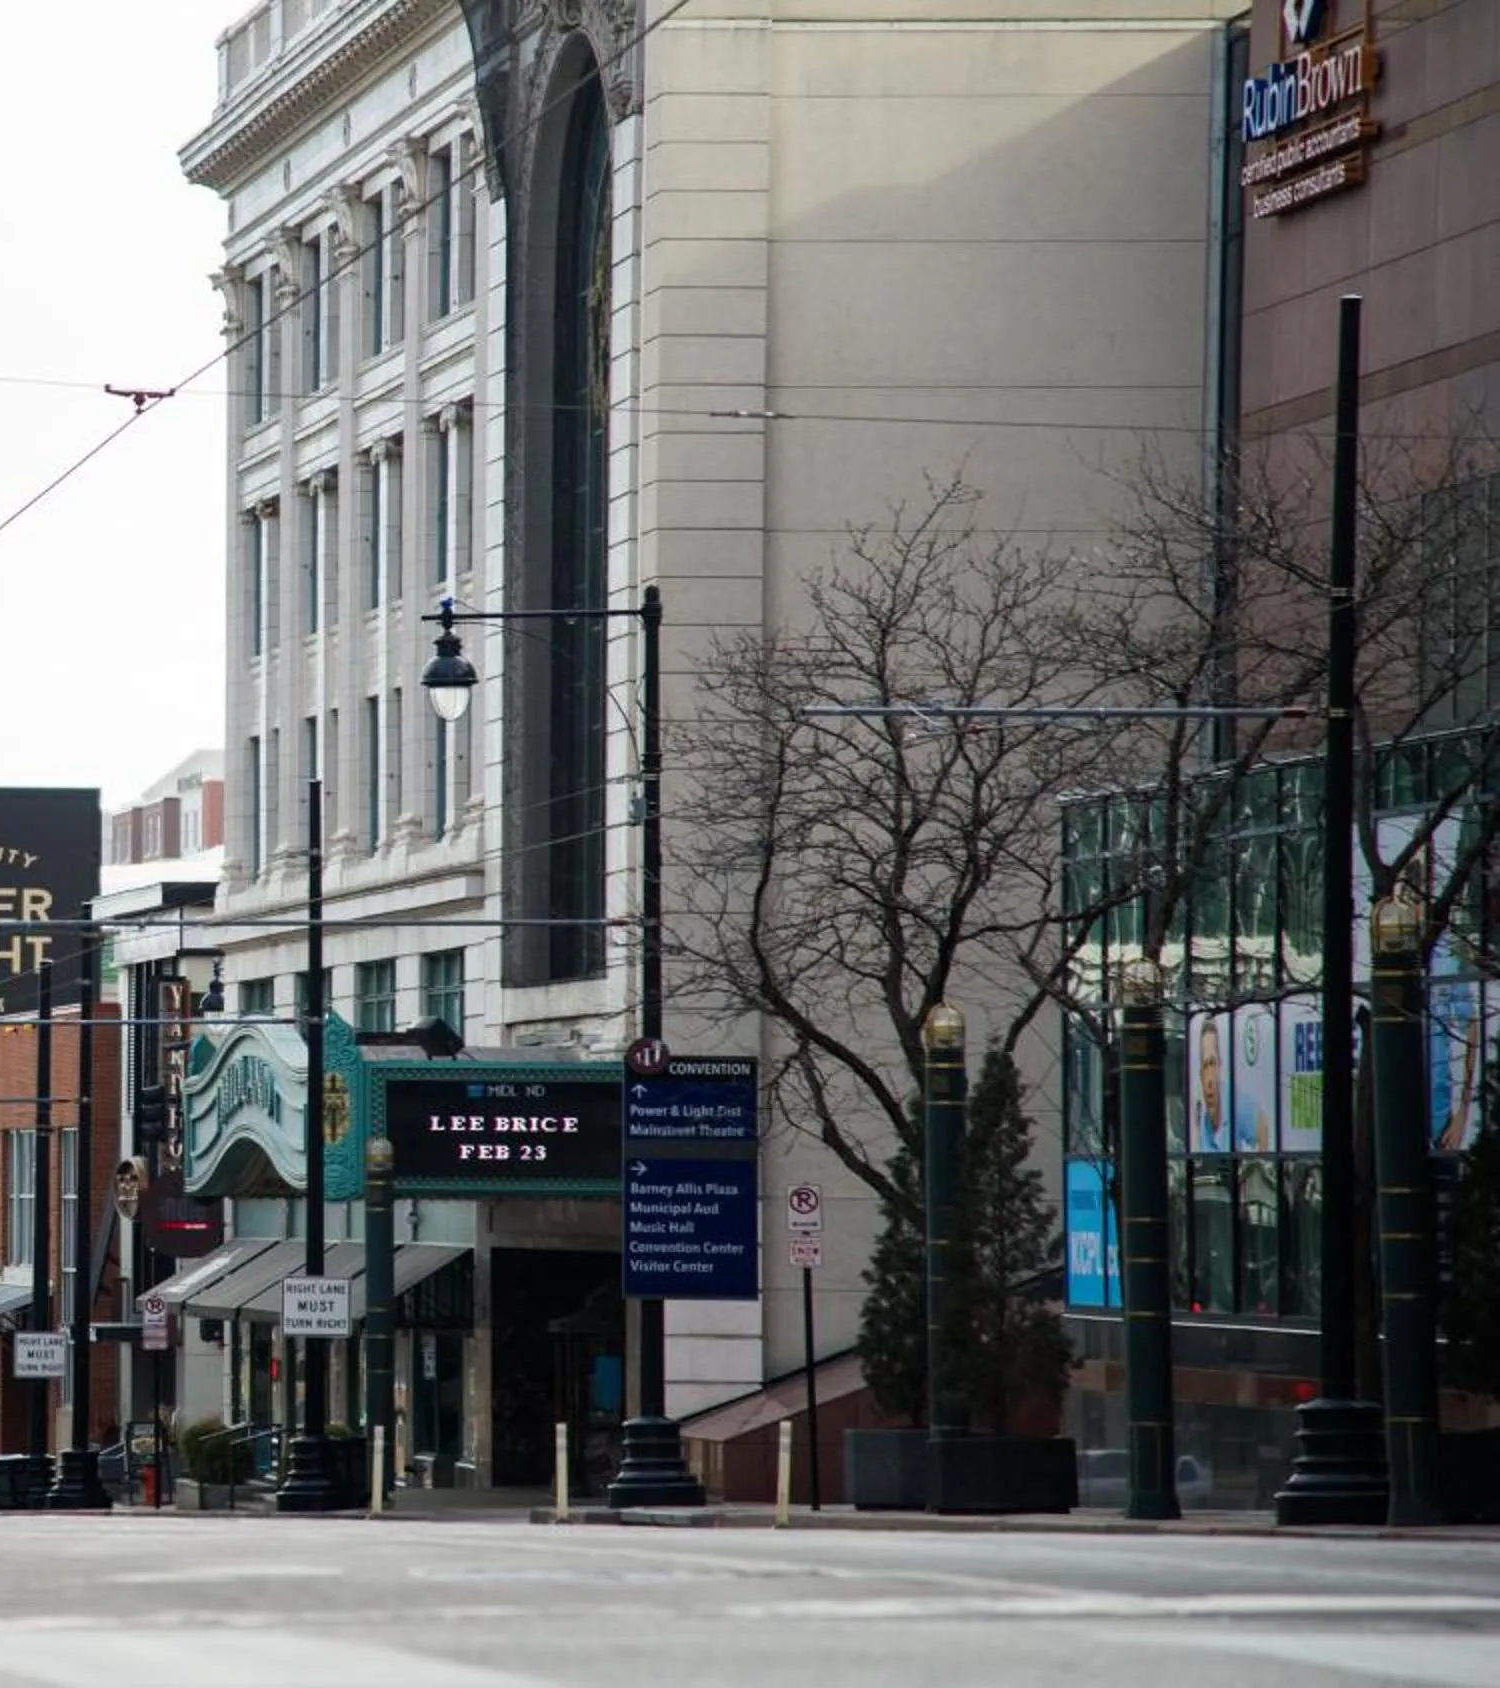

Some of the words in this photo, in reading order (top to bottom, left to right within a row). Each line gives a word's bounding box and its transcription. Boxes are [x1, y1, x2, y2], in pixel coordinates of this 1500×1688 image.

[1241, 46, 1363, 143] RubinBrown
[668, 1062, 751, 1075] CONVENTION
[629, 1104, 668, 1117] Power
[670, 1104, 681, 1117] &
[683, 1104, 715, 1119] Light
[430, 1116, 485, 1131] LEE
[495, 1117, 579, 1133] BRICE
[460, 1145, 510, 1160] FEB
[520, 1145, 547, 1161] 23
[630, 1182, 673, 1198] Barney
[675, 1183, 703, 1195] Allis
[705, 1183, 739, 1195] Plaza
[629, 1202, 692, 1216] Municipal
[694, 1202, 720, 1215] Aud
[629, 1221, 667, 1233] Music
[668, 1221, 695, 1233] Hall
[629, 1241, 701, 1253] Convention
[703, 1241, 744, 1255] Center
[630, 1259, 671, 1272] Visitor
[673, 1260, 714, 1273] Center
[286, 1284, 316, 1294] RIGHT
[320, 1284, 346, 1295] LANE
[297, 1300, 335, 1313] MUST
[286, 1318, 313, 1328] TURN
[316, 1318, 347, 1328] RIGHT
